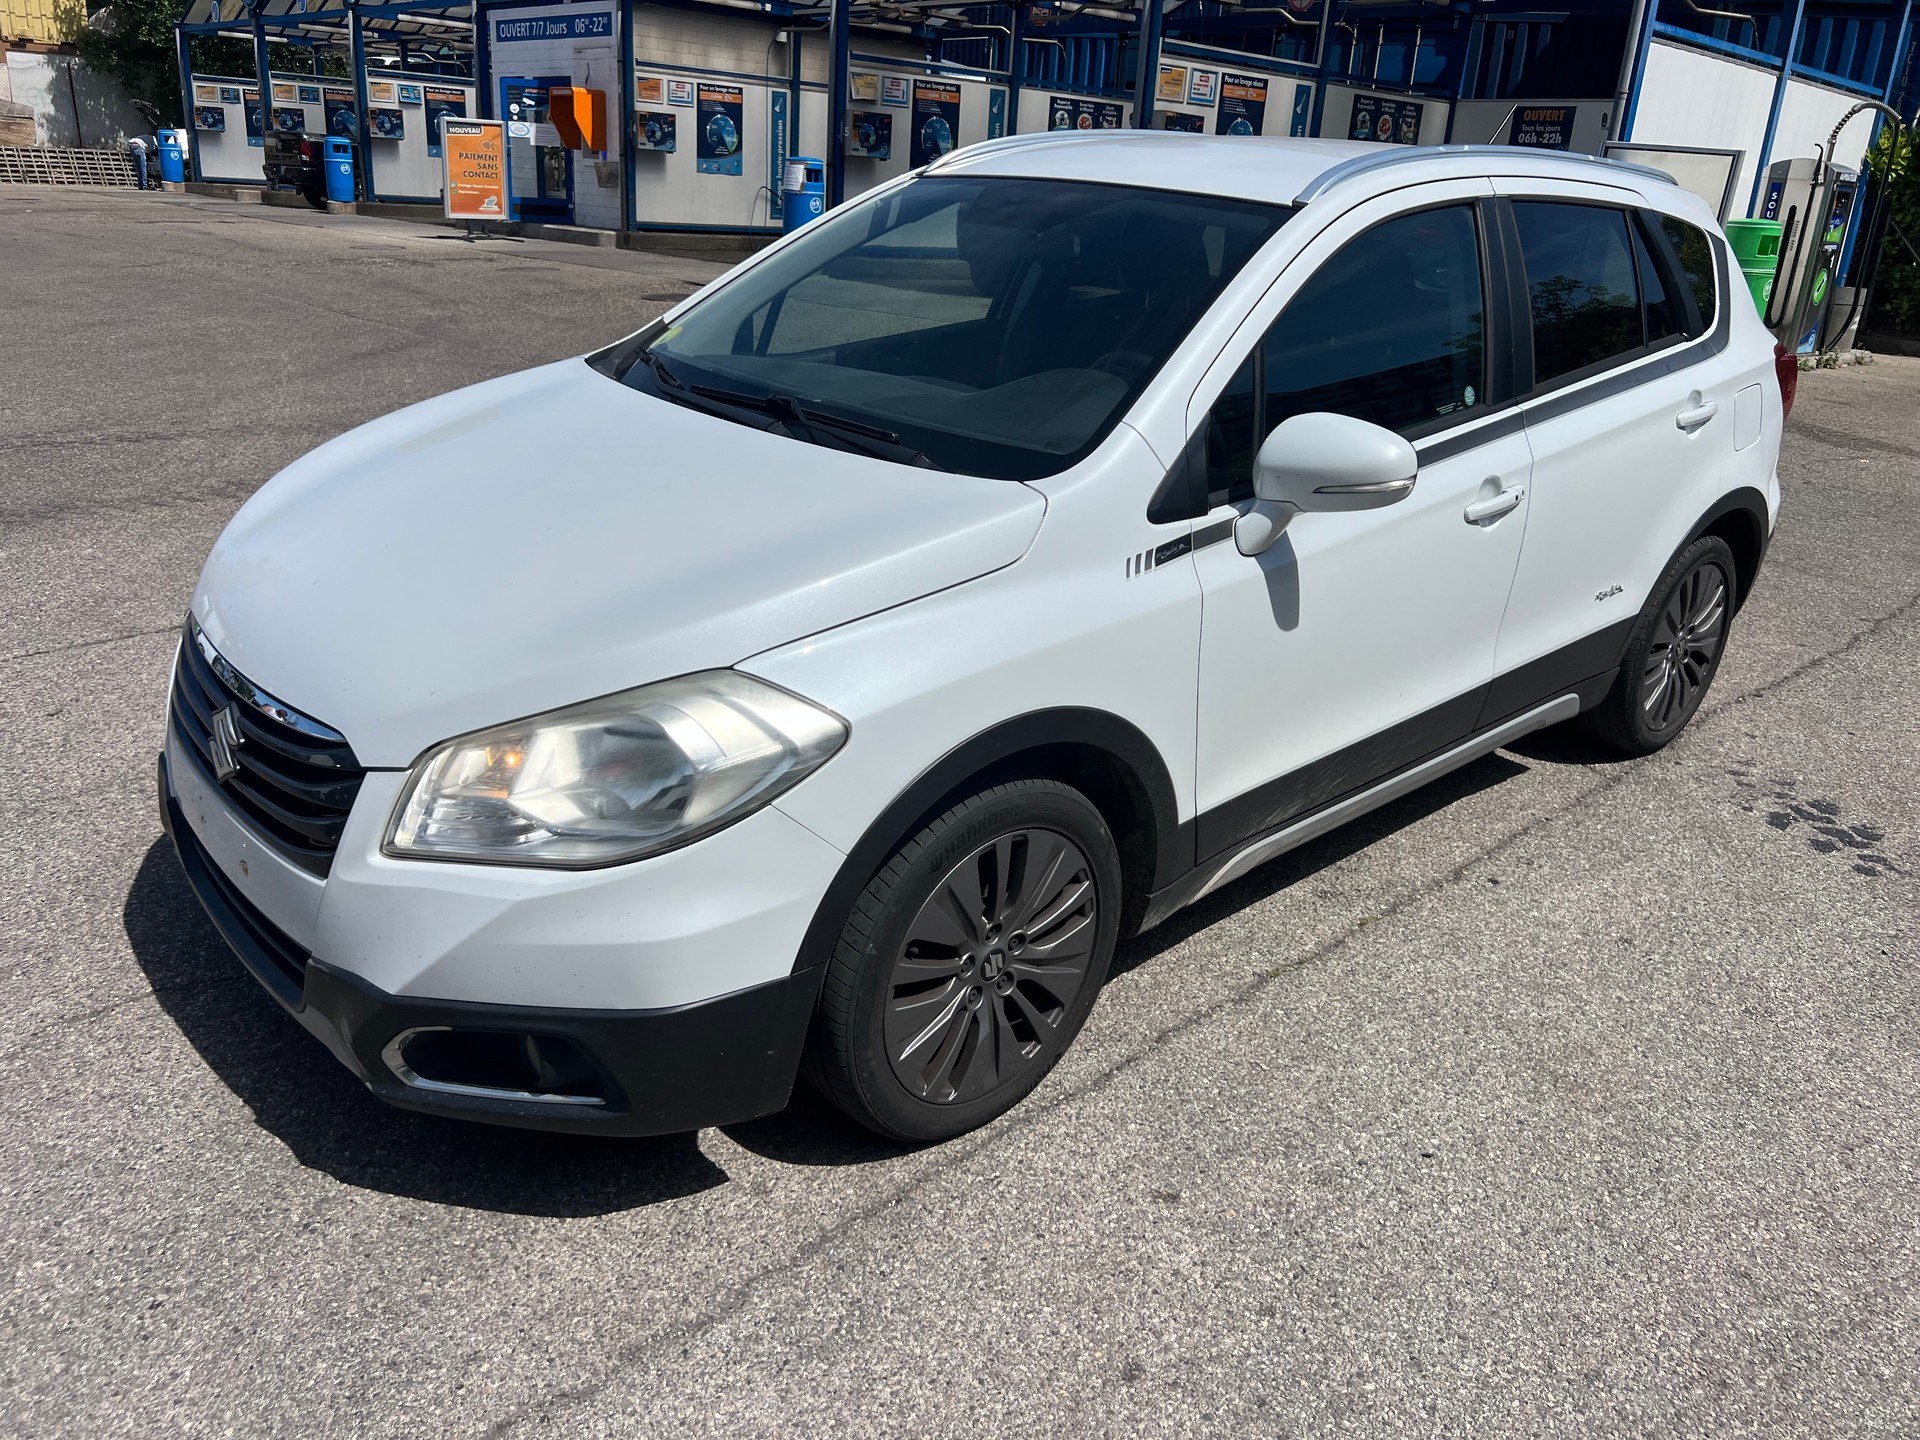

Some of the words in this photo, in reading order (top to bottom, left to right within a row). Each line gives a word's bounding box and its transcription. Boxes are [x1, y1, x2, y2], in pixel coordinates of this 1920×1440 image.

[500, 22, 530, 38] OUVERT
[532, 22, 544, 36] 7/7
[546, 21, 567, 36] Jours
[932, 82, 946, 91] lavage
[1240, 77, 1252, 87] lavage
[1524, 110, 1566, 121] OUVERT
[844, 127, 850, 136] 5
[1545, 124, 1560, 132] jours
[1518, 133, 1536, 143] 06h
[459, 152, 498, 162] PAIEMENT
[463, 170, 498, 179] CONTACT
